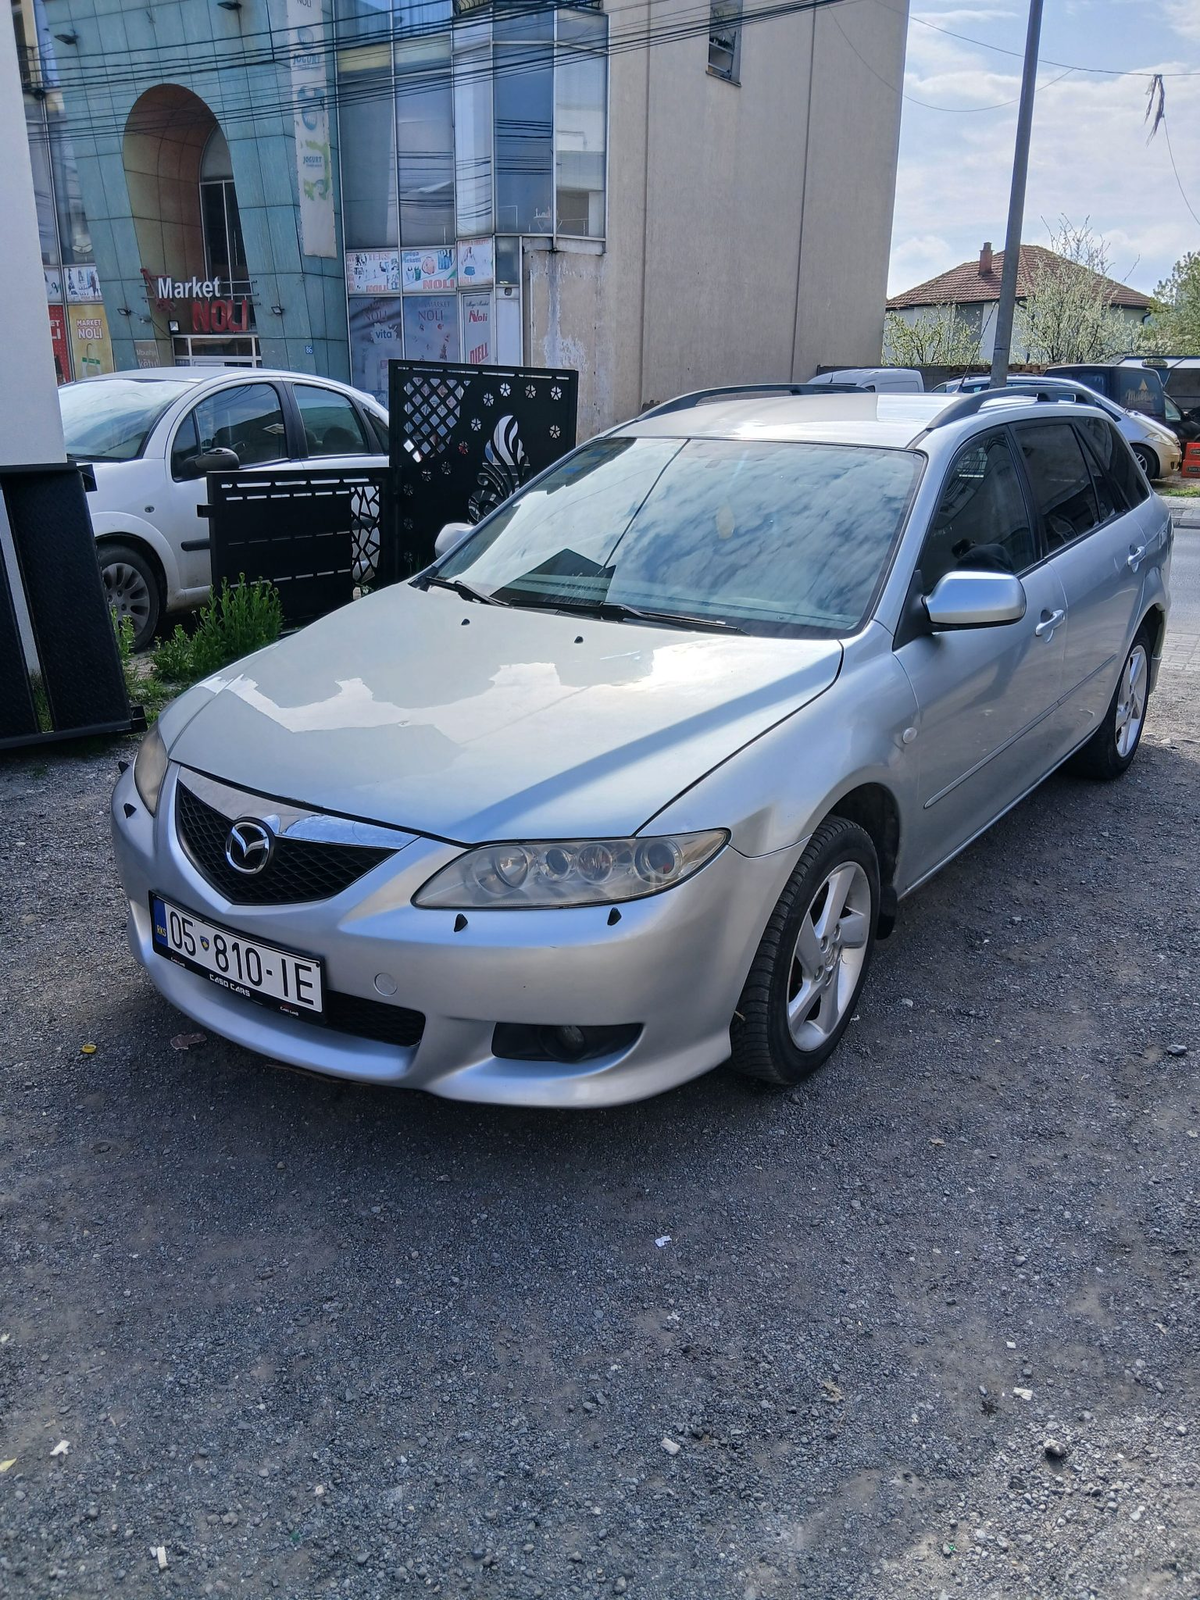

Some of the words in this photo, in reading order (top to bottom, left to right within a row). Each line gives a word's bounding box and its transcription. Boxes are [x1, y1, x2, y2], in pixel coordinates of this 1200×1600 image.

[303, 156, 322, 164] JOGURT
[158, 276, 222, 299] Market
[423, 280, 455, 290] NOLI
[192, 299, 249, 333] NOLI
[419, 310, 444, 321] NOLI
[78, 328, 103, 339] NOLI
[375, 329, 393, 339] vita
[156, 924, 167, 938] RKS
[169, 911, 197, 957] 05
[230, 983, 251, 998] CARS
